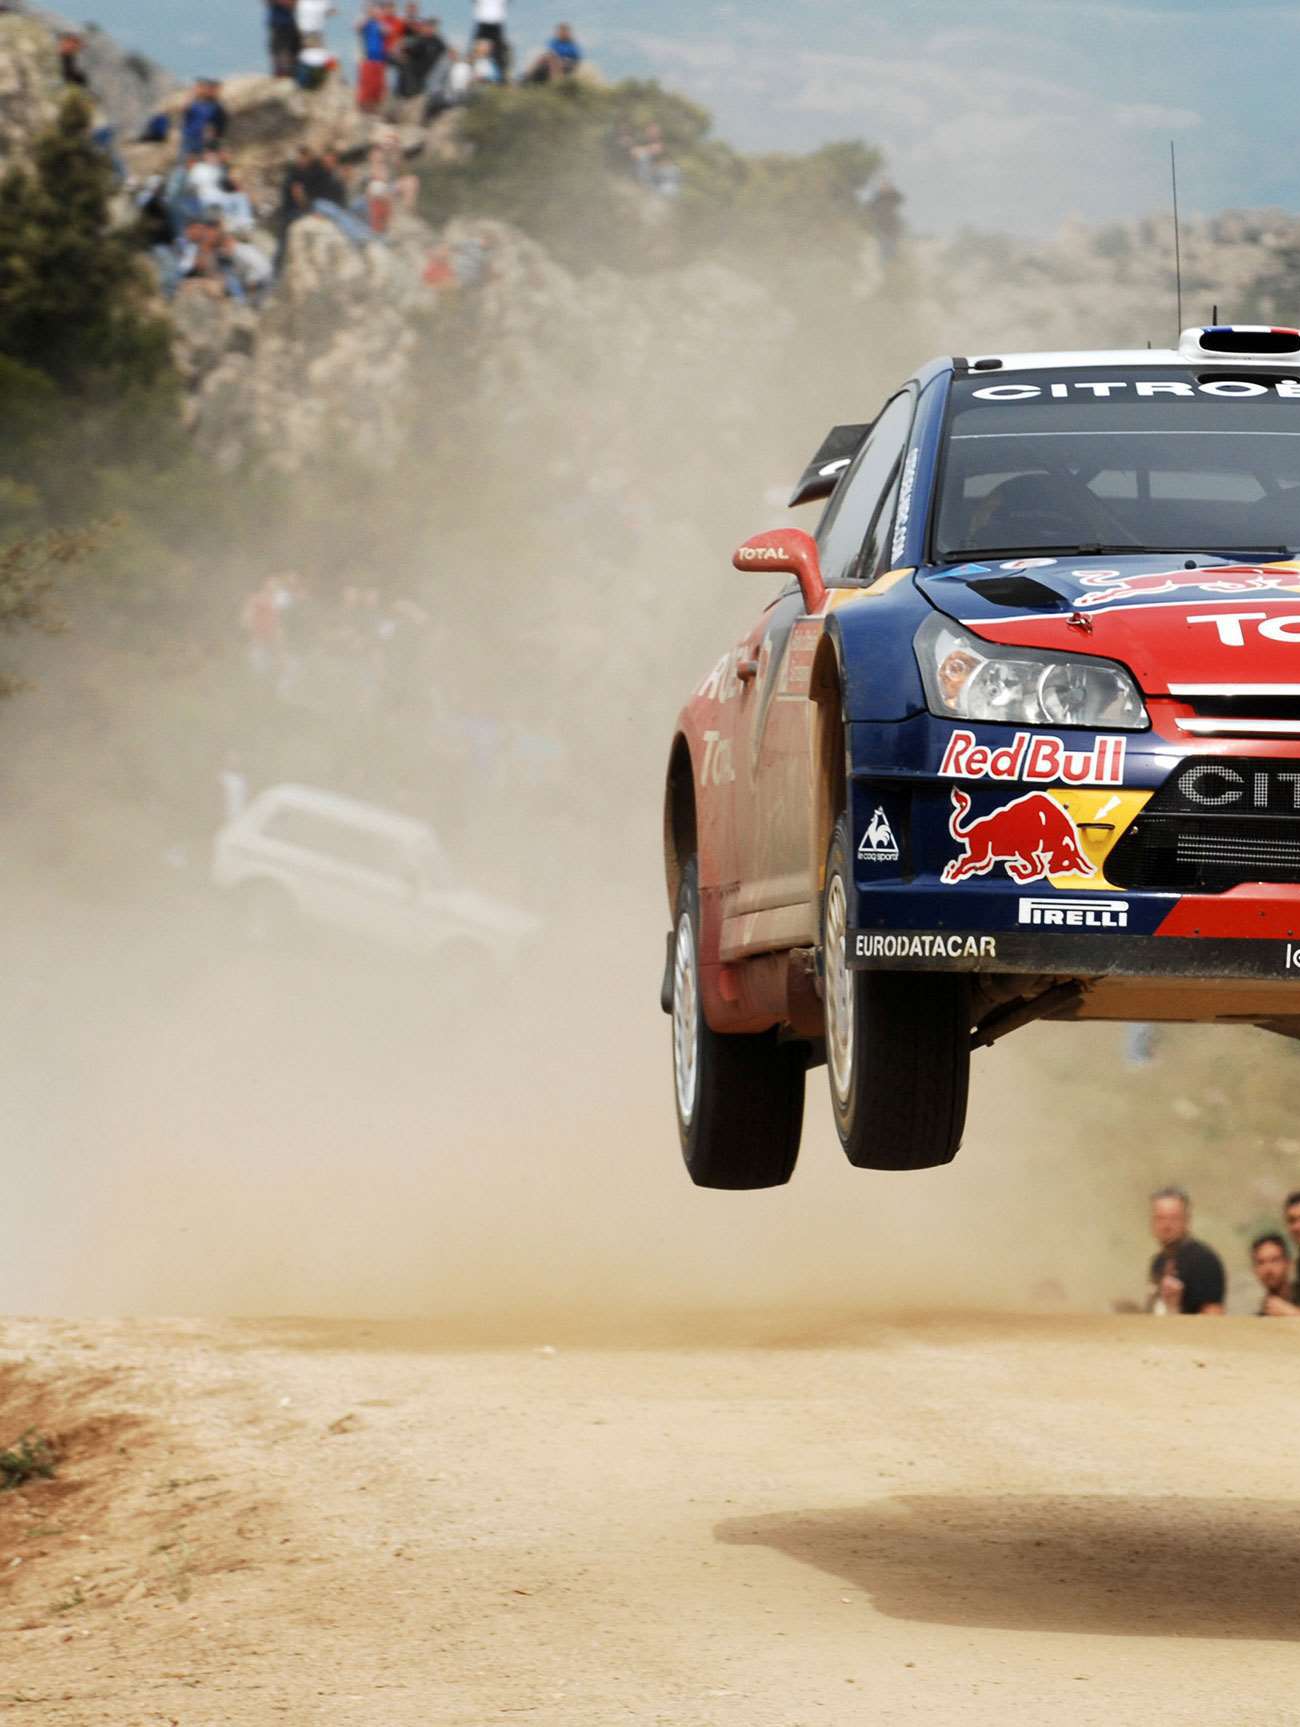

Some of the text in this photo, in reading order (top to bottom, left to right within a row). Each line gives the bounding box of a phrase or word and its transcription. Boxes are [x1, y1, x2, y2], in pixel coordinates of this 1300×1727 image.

[738, 546, 790, 561] TOTAL
[1018, 897, 1129, 928] PIRELLI
[855, 935, 996, 958] EURODATACAR
